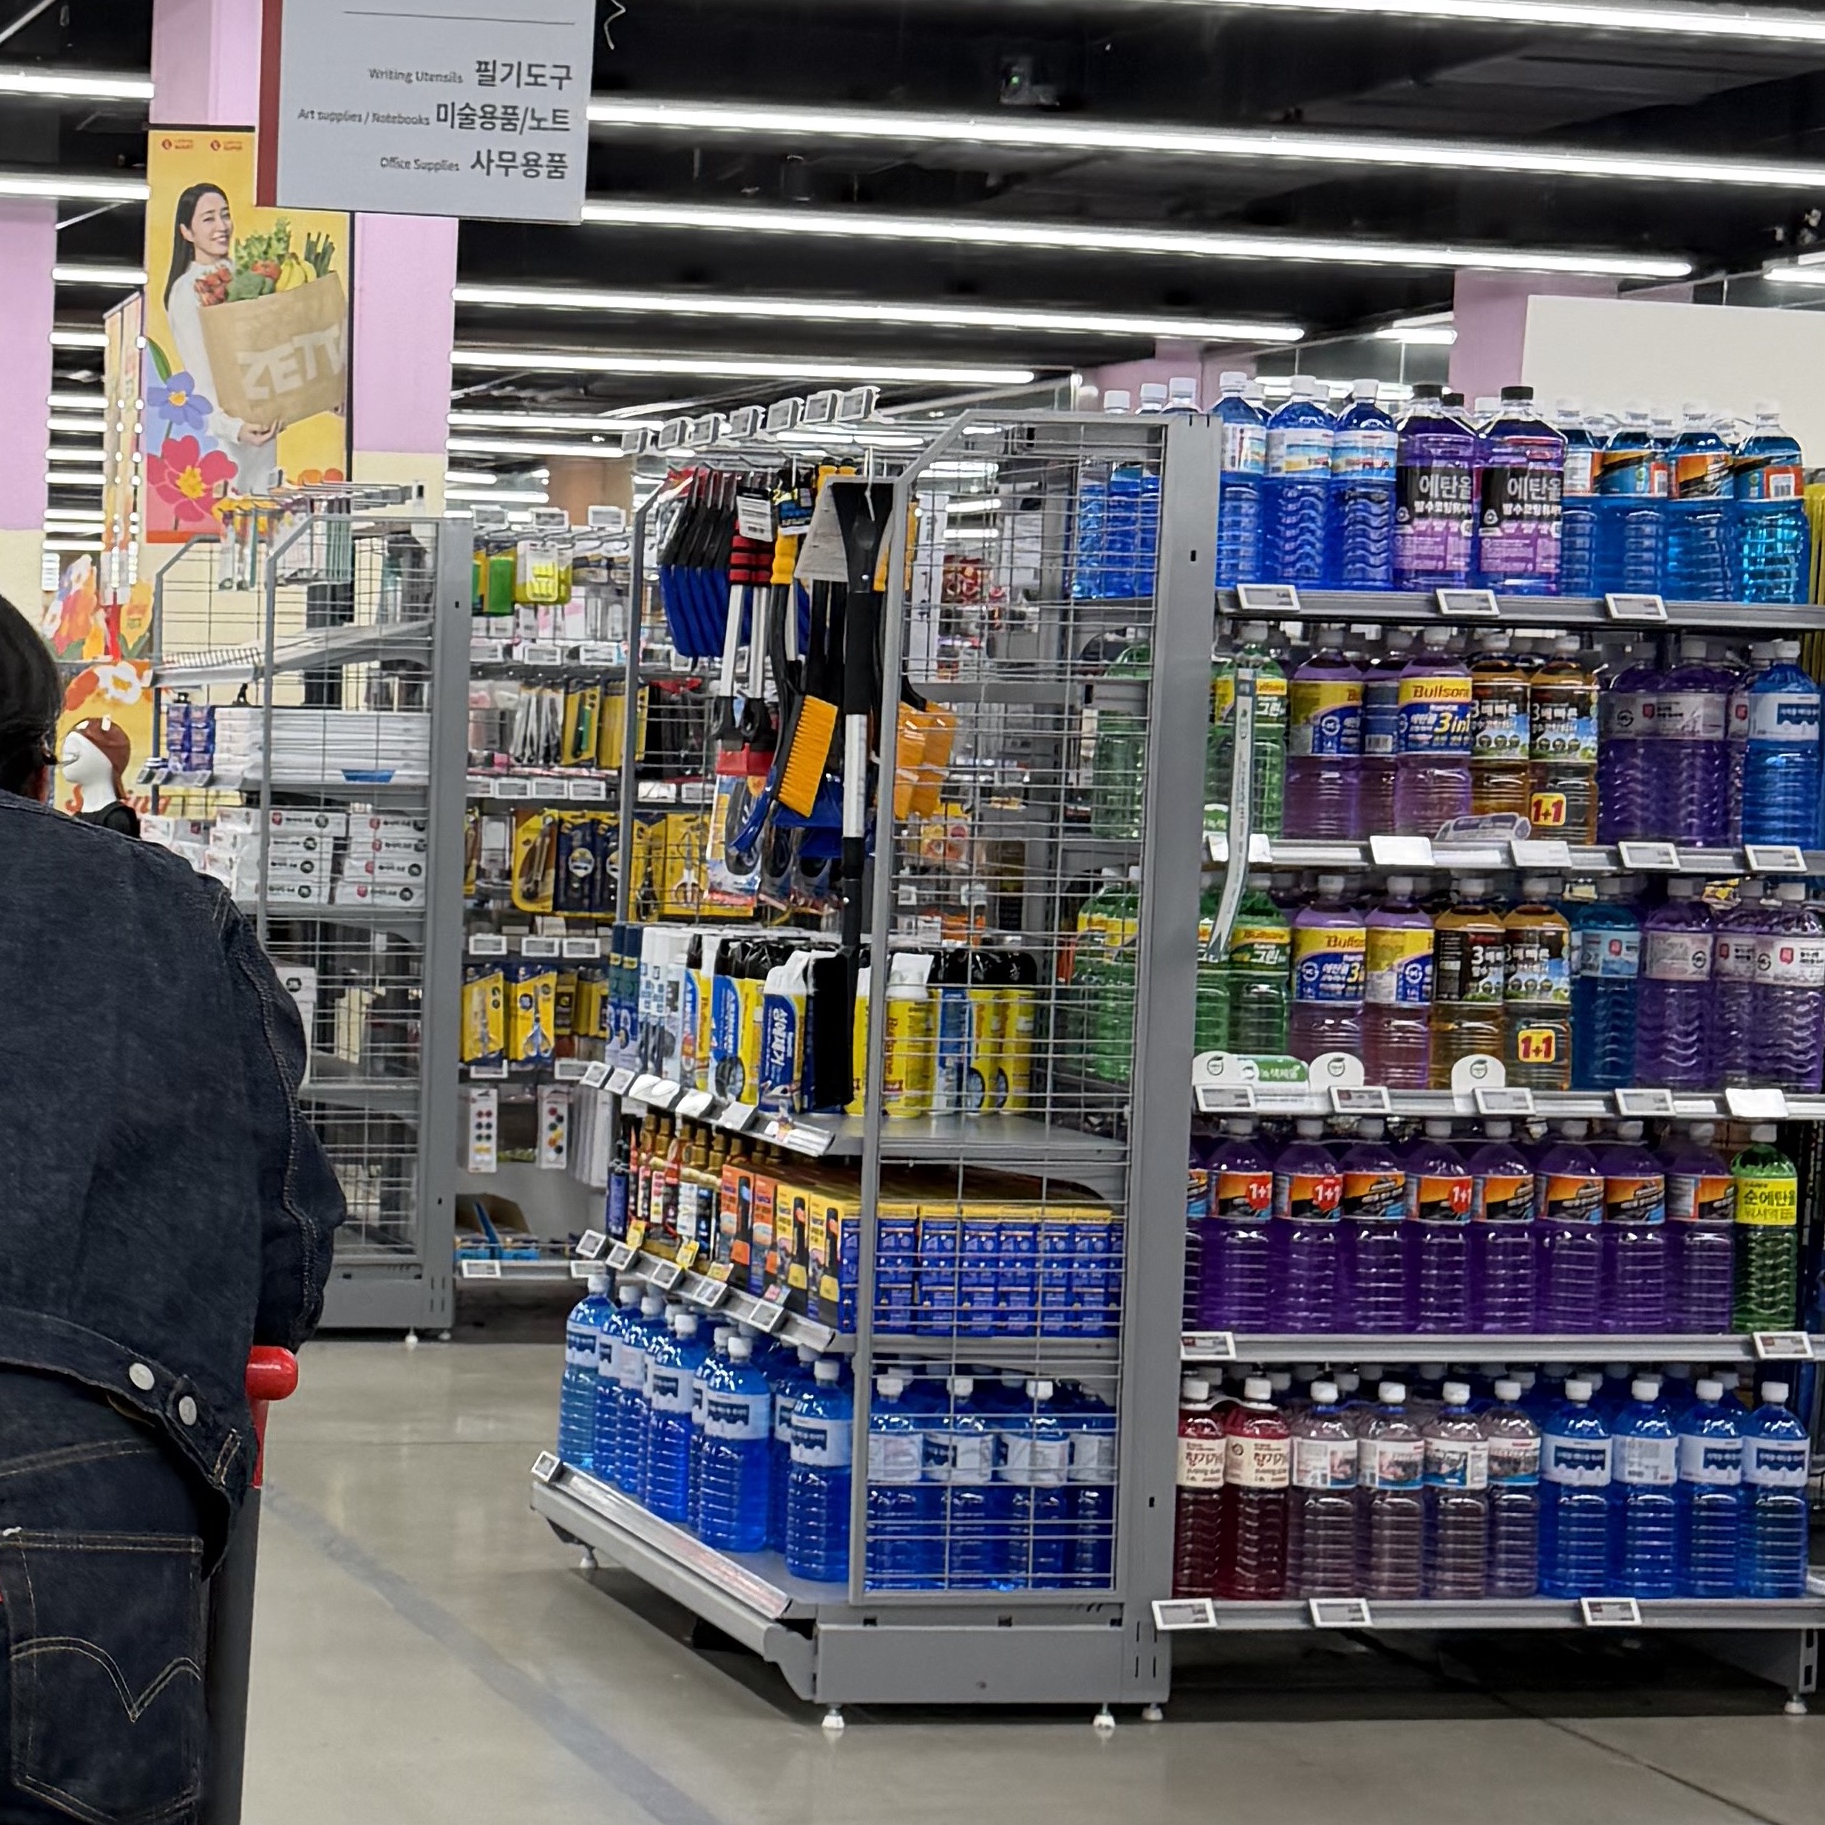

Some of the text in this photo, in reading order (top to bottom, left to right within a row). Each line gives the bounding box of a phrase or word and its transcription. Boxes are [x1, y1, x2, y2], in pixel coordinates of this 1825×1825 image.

[368, 68, 463, 84] Writing Utensils
[475, 59, 573, 91] 필기도구
[297, 108, 315, 120] Art
[371, 113, 430, 126] Notebooks
[436, 102, 571, 135] 미술용품/노트
[380, 157, 460, 173] Office Supplies
[470, 149, 569, 180] 사무용품
[1419, 475, 1472, 500] 에탄올
[1507, 478, 1562, 502] 에탄올
[1532, 798, 1564, 820] 1+1
[1521, 1036, 1553, 1058] 1+1
[1315, 1184, 1341, 1202] 1+1
